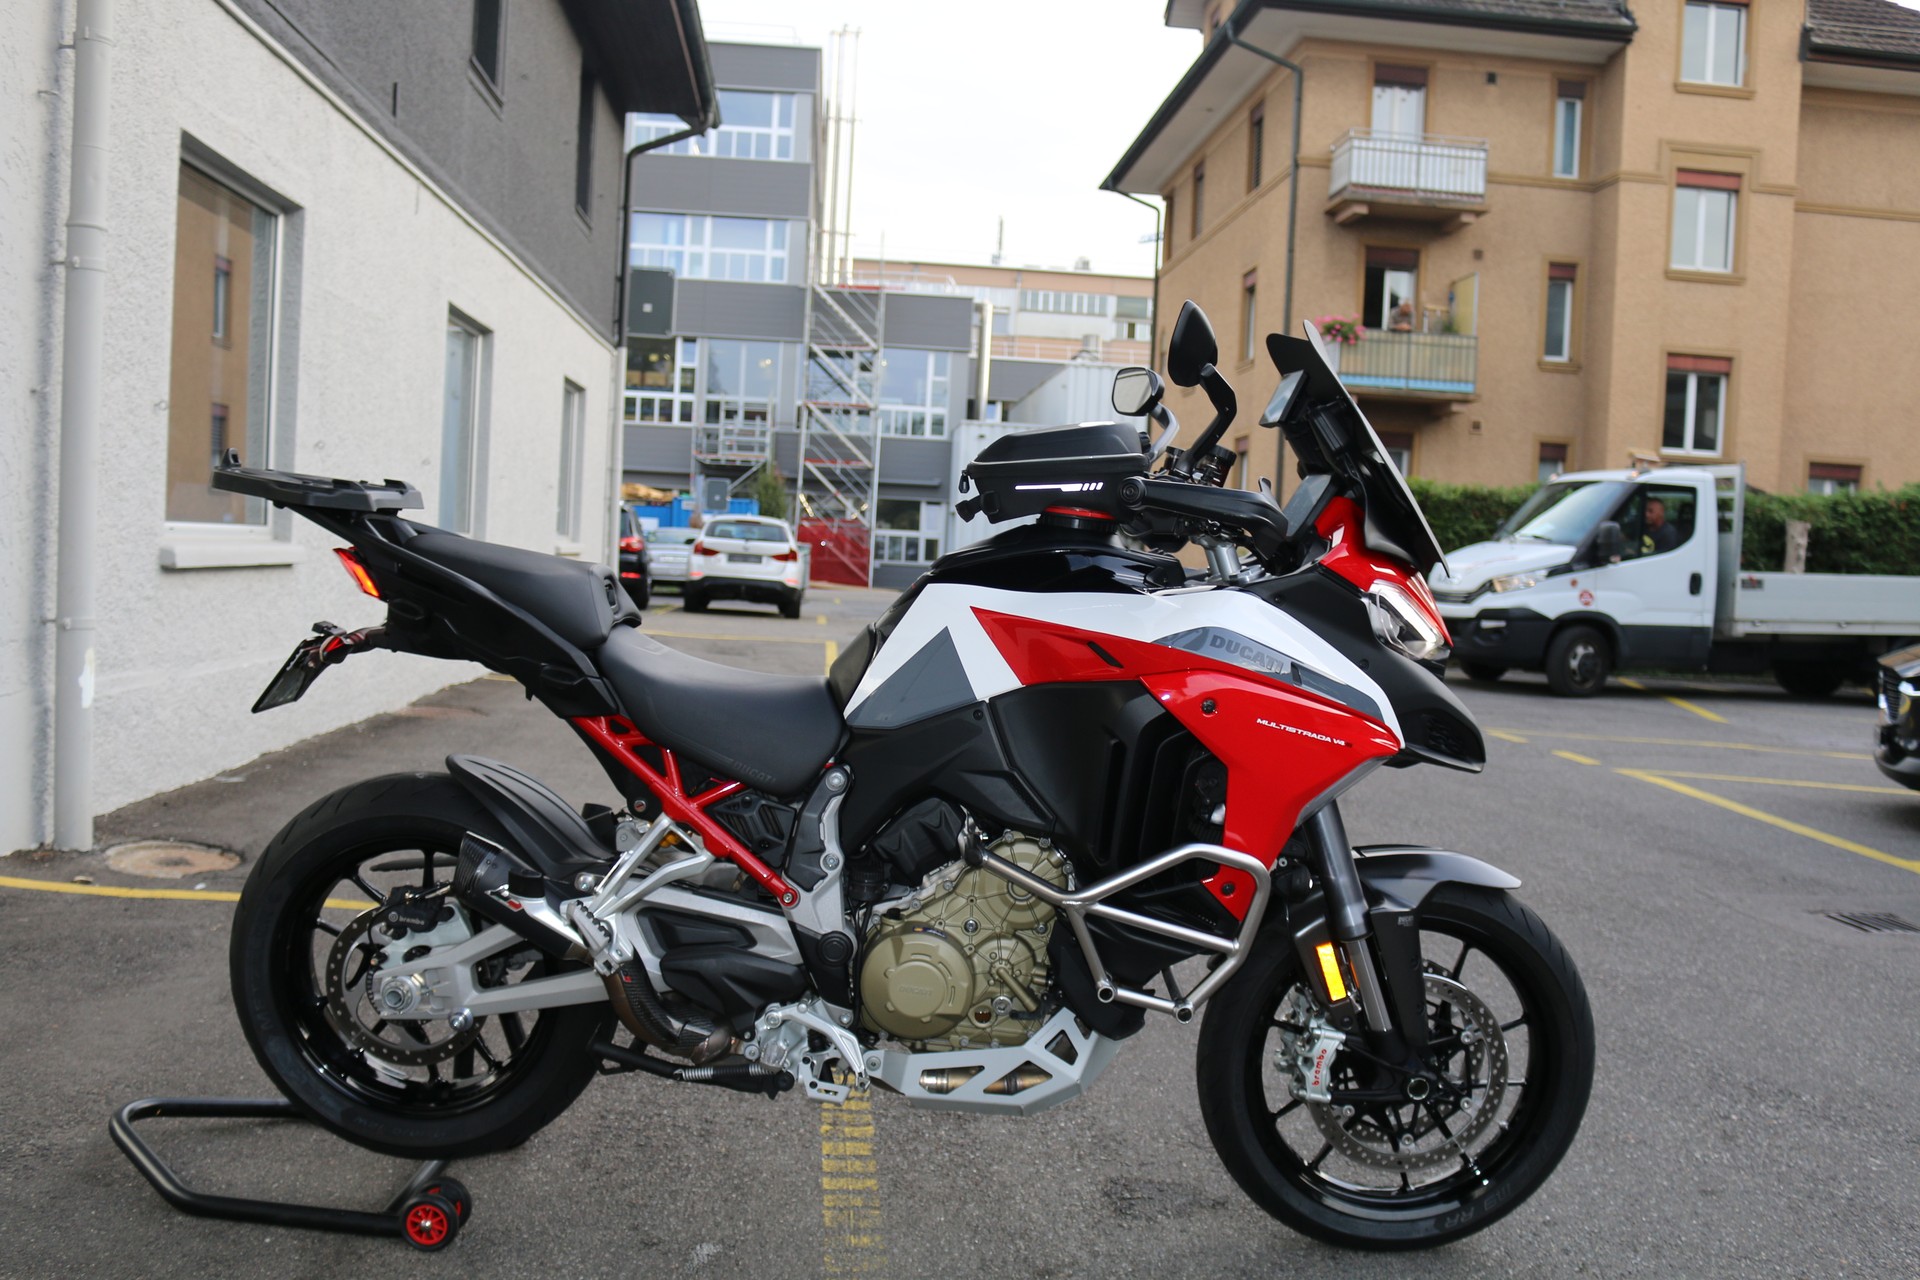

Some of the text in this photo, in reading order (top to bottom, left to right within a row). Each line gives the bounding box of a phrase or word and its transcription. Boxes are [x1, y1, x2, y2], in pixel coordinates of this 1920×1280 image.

[1209, 634, 1284, 674] DUCATI
[1256, 718, 1332, 743] MULTISTRADA
[398, 914, 425, 926] brembo
[1311, 1048, 1328, 1087] brembo
